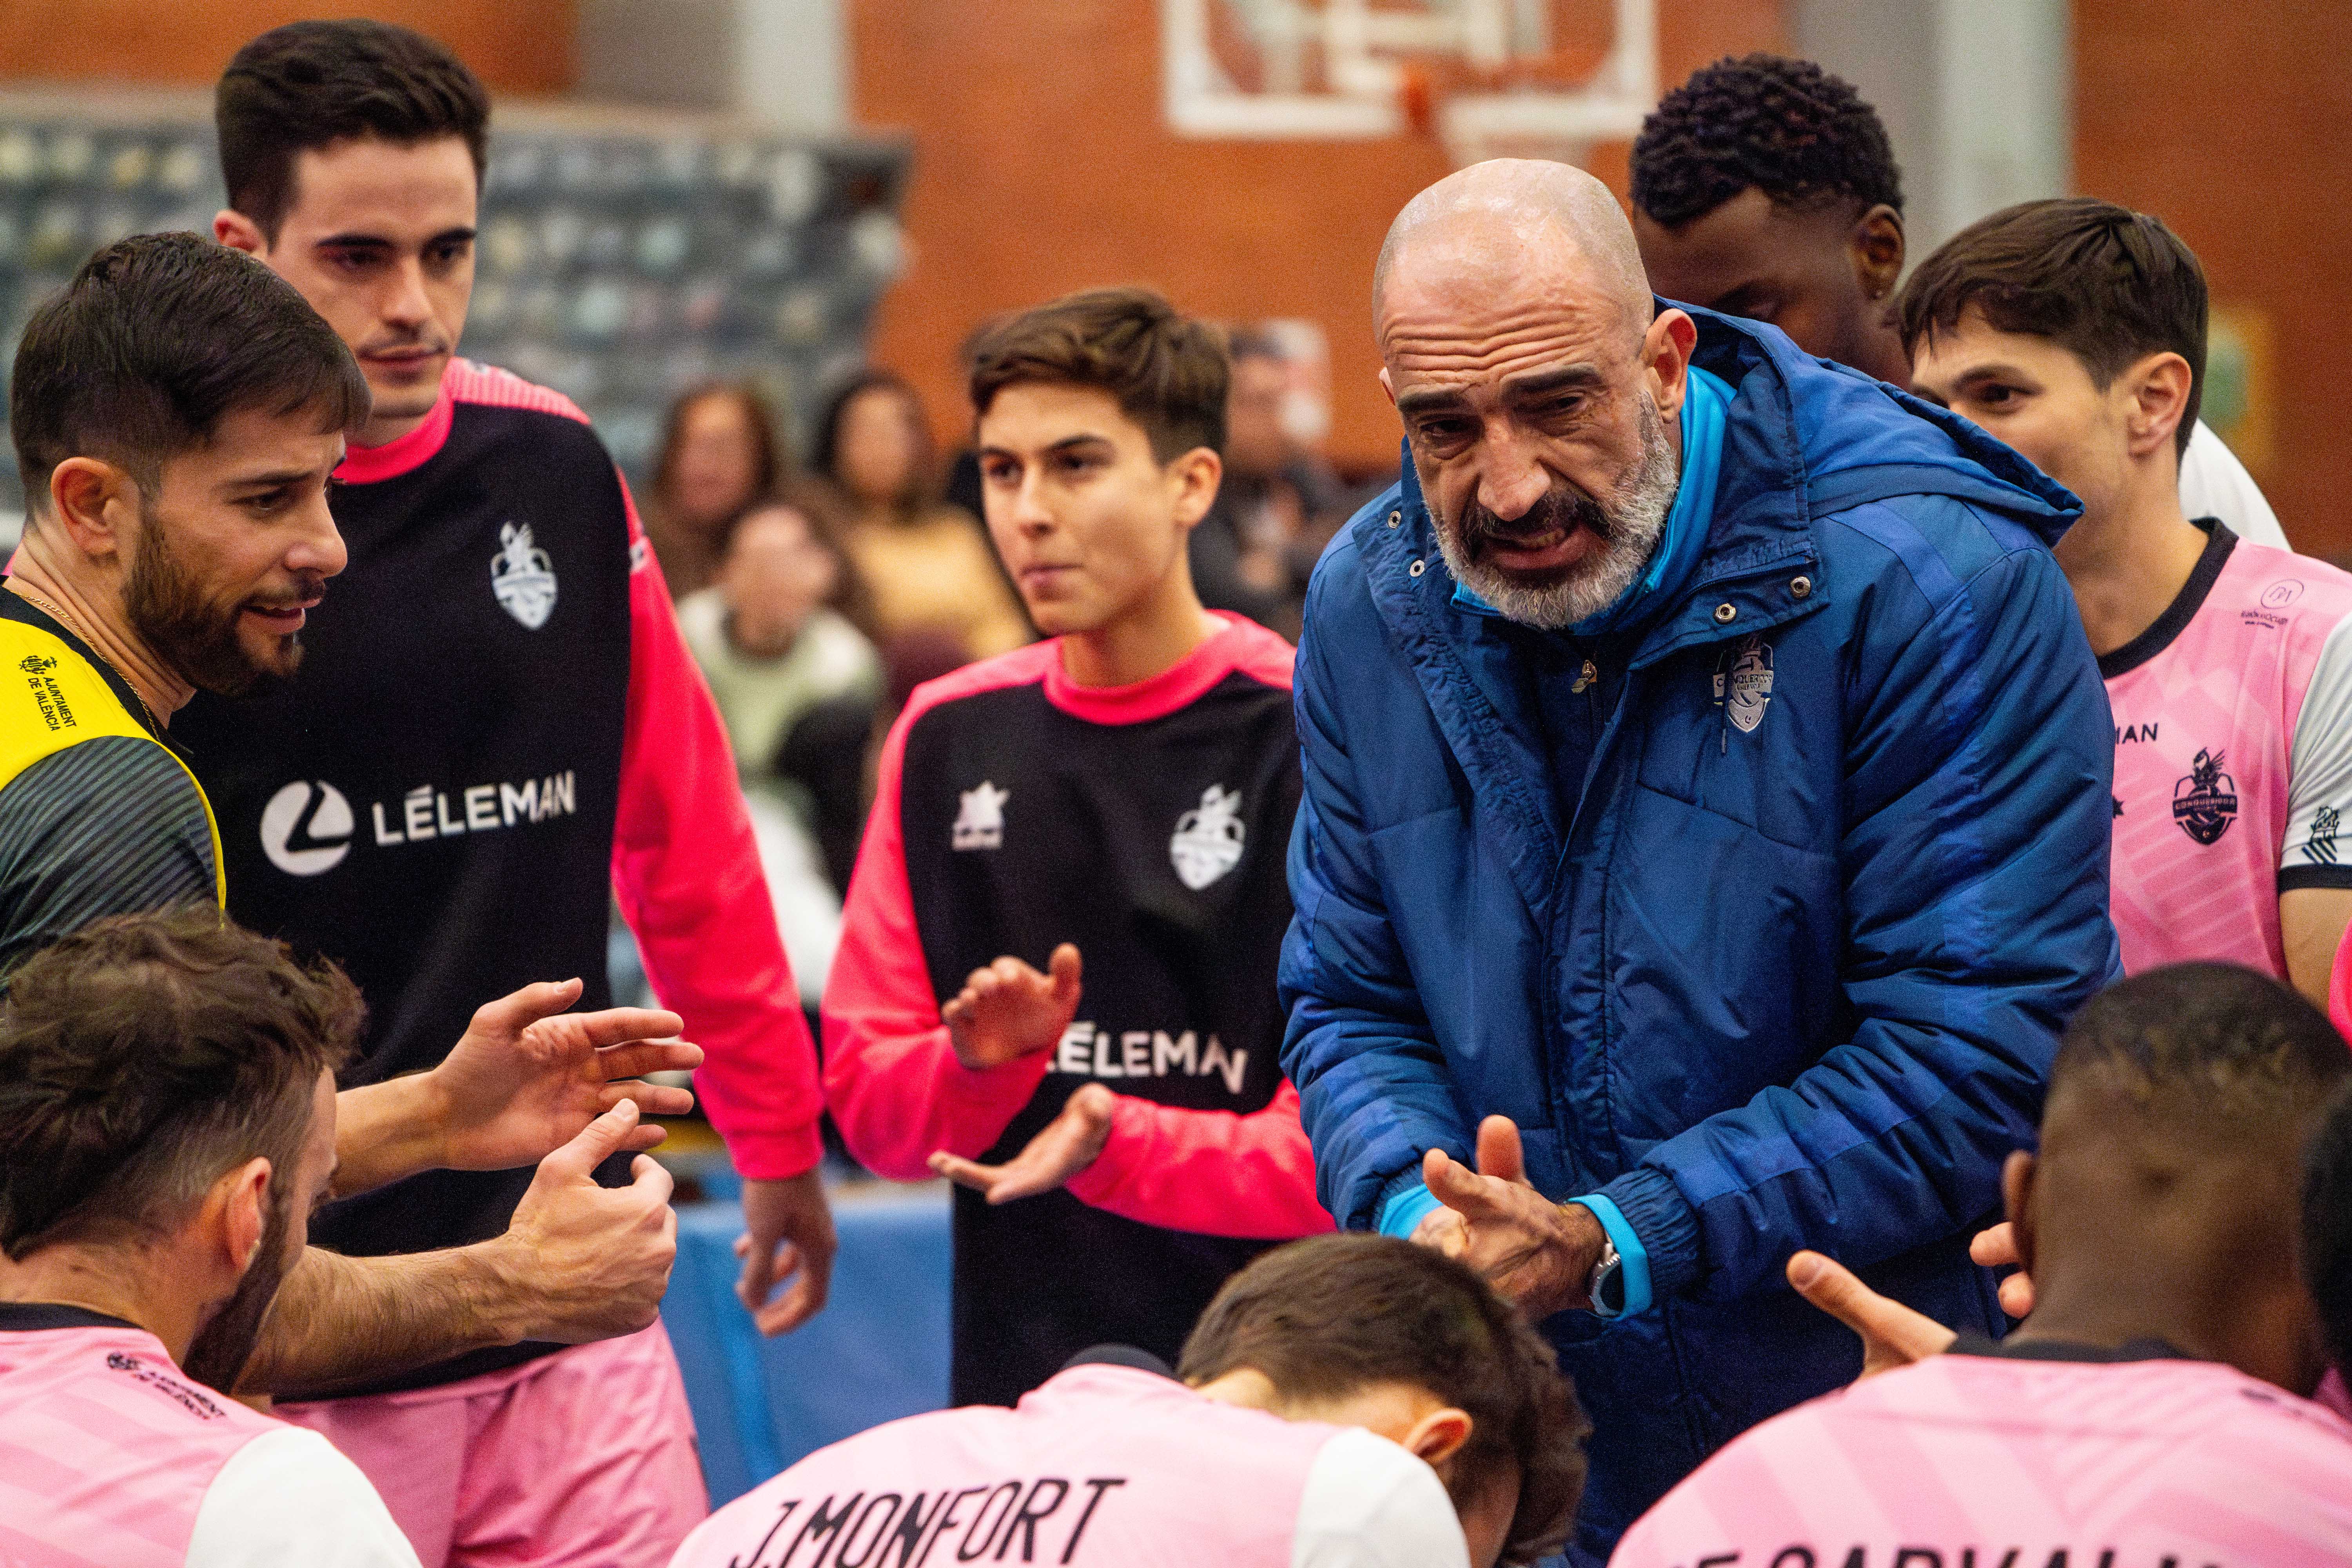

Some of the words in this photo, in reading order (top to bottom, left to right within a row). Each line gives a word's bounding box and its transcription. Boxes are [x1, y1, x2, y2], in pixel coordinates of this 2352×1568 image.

[28, 678, 42, 689] DE
[43, 677, 76, 727] AJUNTAMENT
[34, 691, 60, 731] VALÈNCIA
[372, 771, 575, 845] LÉLEMAN
[1045, 1021, 1248, 1094] ÉLEMAN
